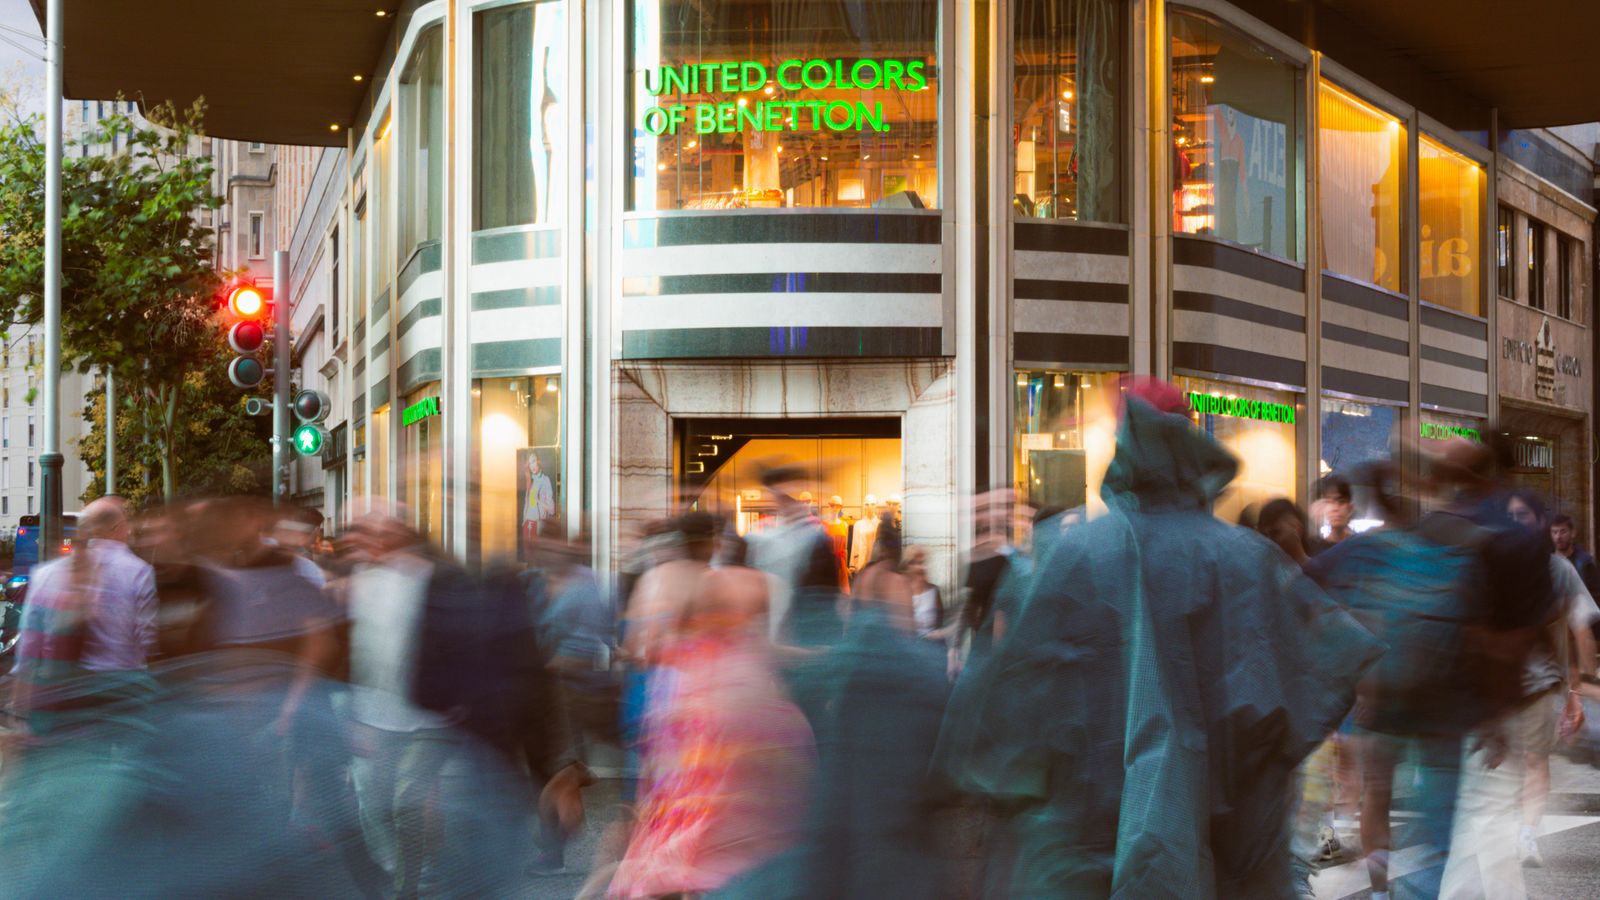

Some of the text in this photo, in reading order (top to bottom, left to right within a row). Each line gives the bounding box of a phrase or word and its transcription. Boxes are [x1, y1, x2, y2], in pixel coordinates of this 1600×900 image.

[644, 58, 927, 96] UNITED COLORS
[642, 99, 890, 136] OF BENETTON.
[1221, 394, 1250, 418] COLORS
